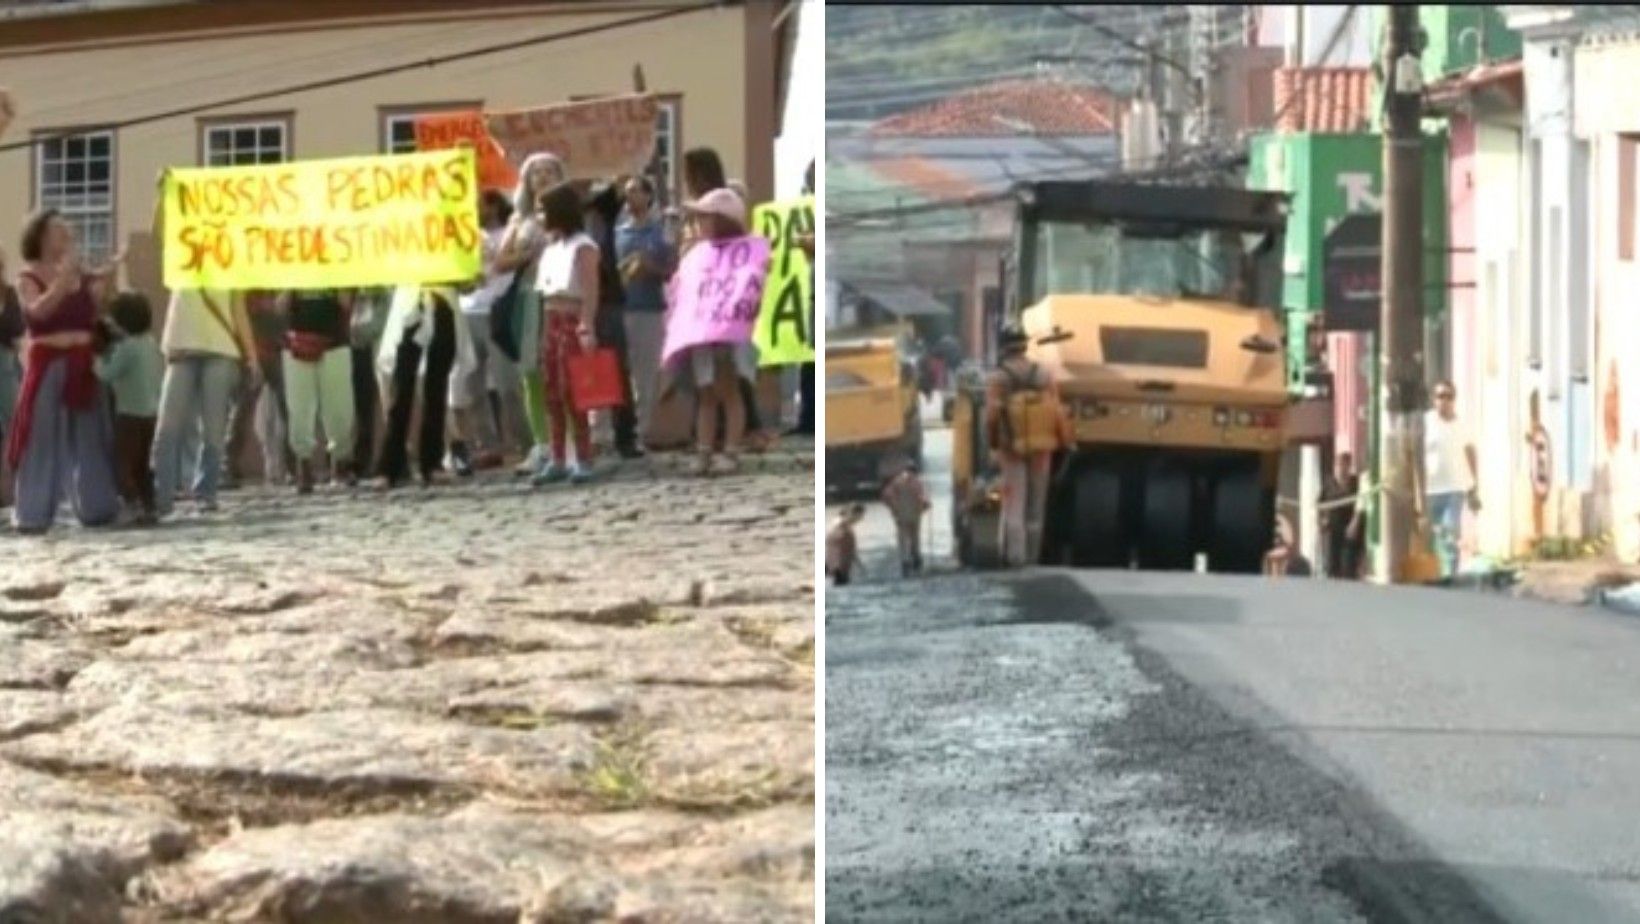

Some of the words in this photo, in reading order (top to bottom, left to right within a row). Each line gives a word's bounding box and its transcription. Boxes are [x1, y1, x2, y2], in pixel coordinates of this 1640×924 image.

[178, 173, 297, 216] NOSSAS
[327, 157, 468, 210] PEDRAS
[178, 220, 234, 272] SÃO
[243, 213, 475, 264] PREDESTINADAS
